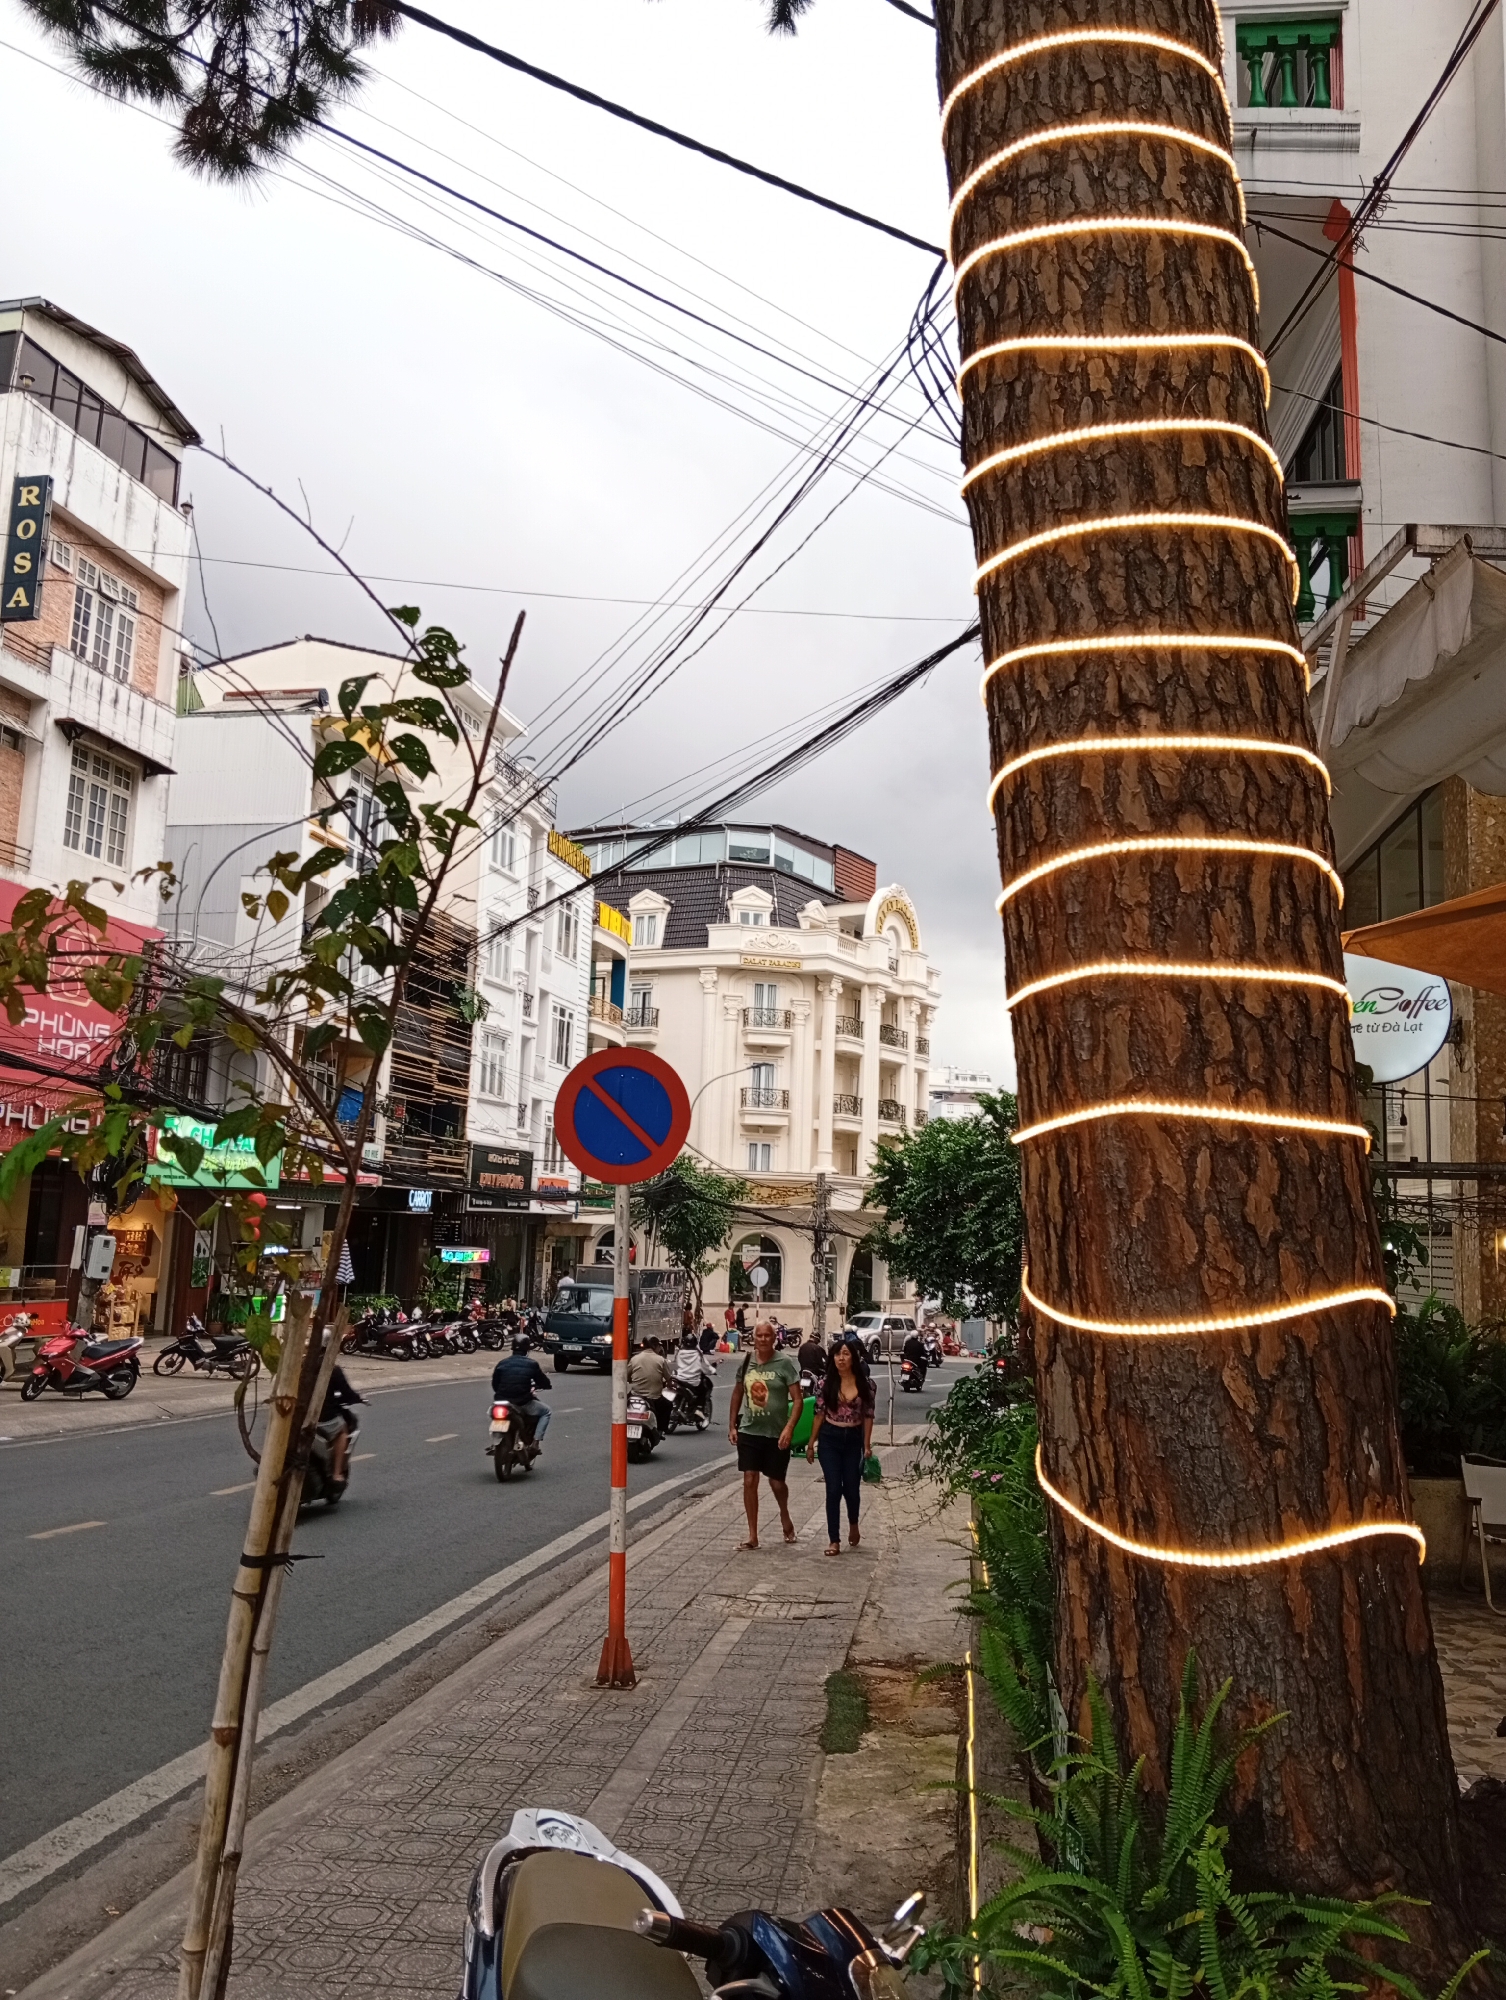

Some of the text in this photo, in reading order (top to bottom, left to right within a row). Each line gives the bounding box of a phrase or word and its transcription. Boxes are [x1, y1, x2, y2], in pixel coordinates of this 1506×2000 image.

[6, 485, 41, 608] ROSA
[743, 957, 801, 969] DALAT PARADISE
[1360, 986, 1449, 1020] Coffee
[21, 1007, 111, 1045] PHÙNG
[1382, 1021, 1400, 1033] Đà
[1403, 1021, 1424, 1034] Lạt
[37, 1034, 91, 1064] HOA
[409, 1189, 433, 1208] CARROT
